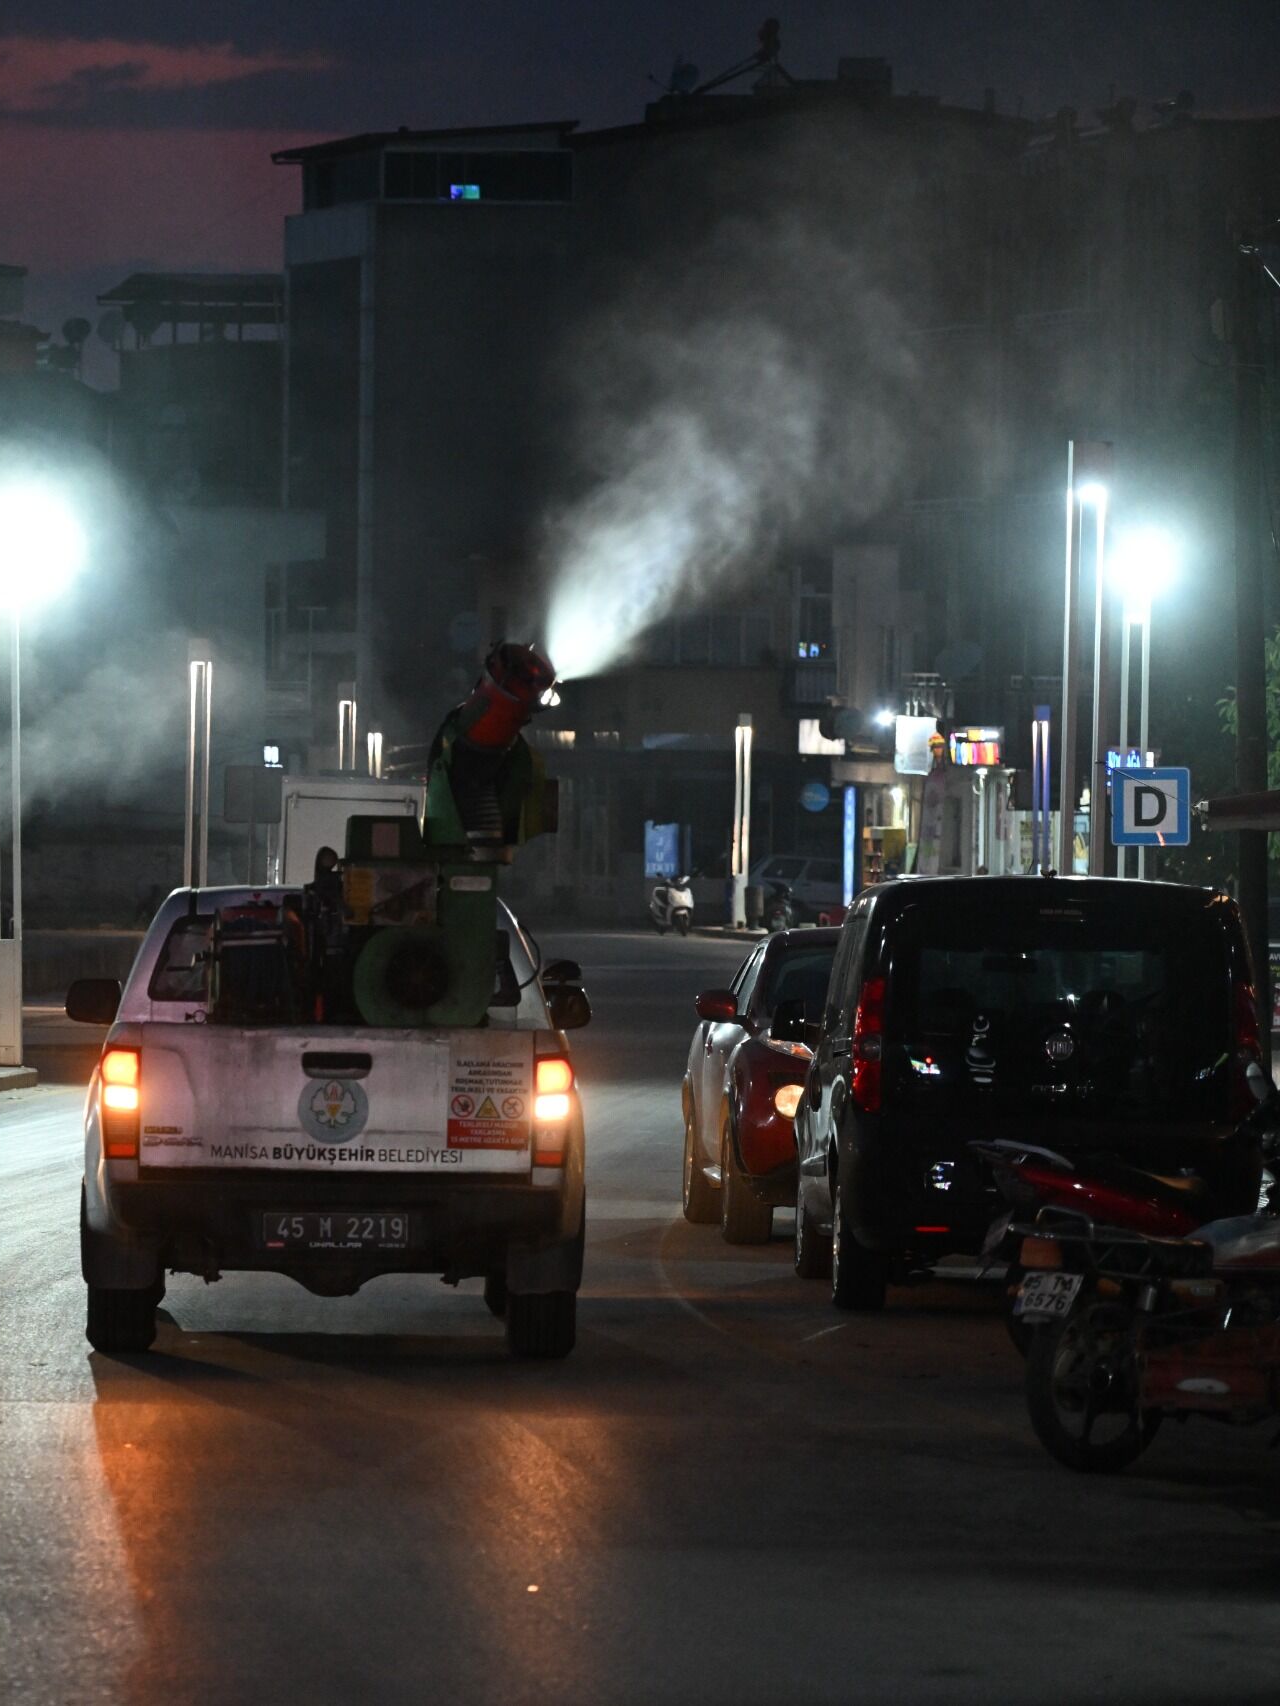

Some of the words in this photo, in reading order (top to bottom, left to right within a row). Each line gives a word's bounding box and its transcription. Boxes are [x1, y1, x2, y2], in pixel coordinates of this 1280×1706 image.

[1134, 786, 1167, 827] D
[210, 1143, 268, 1160] MANİSA
[273, 1143, 375, 1165] BÜYÜKŞEHİR
[277, 1217, 304, 1238] 45
[319, 1217, 332, 1238] M
[347, 1217, 403, 1239] 2219
